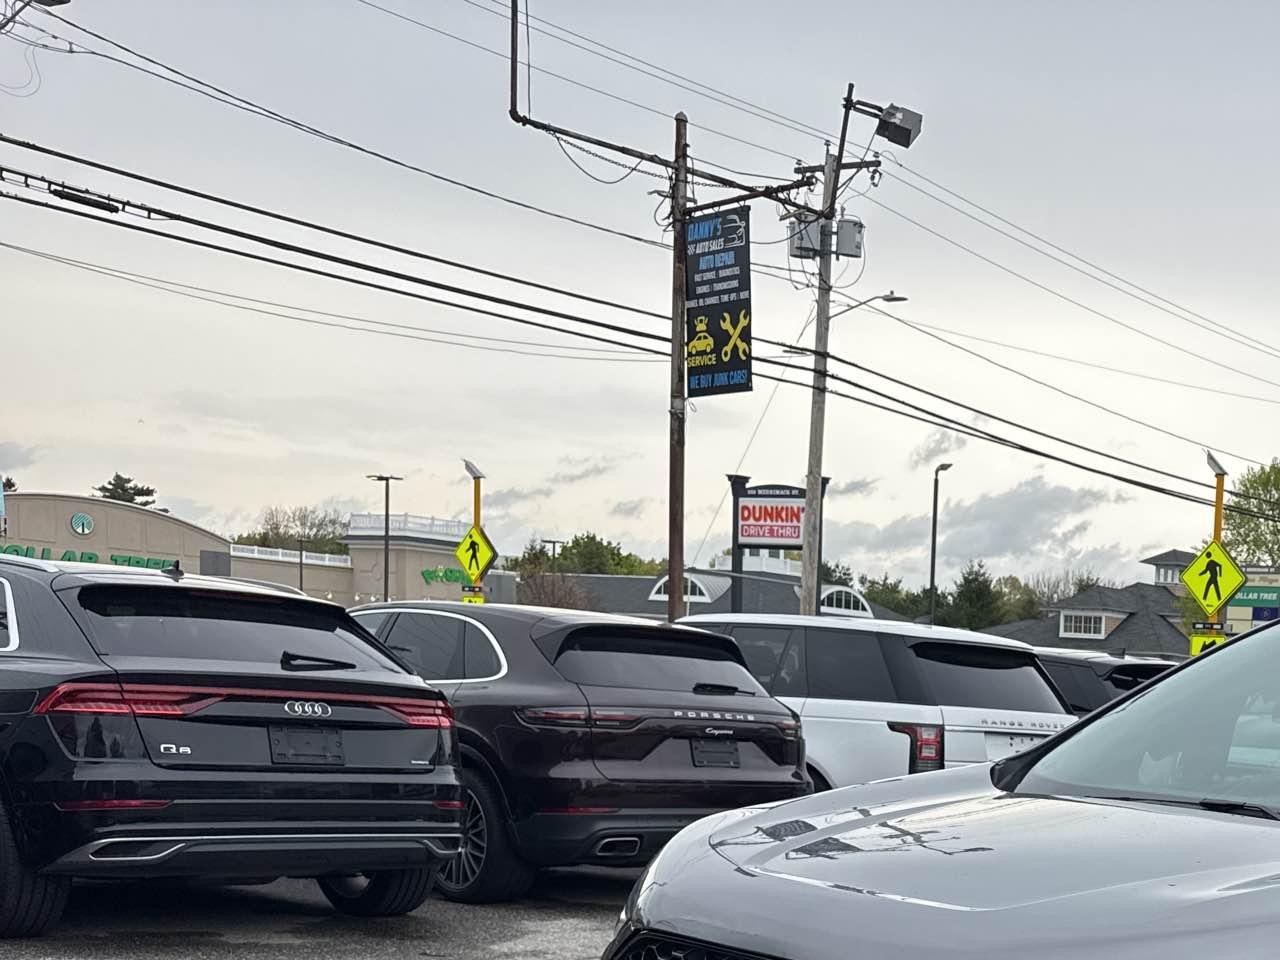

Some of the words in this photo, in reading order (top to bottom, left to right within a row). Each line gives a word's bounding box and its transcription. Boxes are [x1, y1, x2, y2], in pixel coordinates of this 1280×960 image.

[709, 238, 724, 251] SALES
[687, 353, 717, 367] SERVICE
[741, 505, 805, 523] DUNKIN'
[743, 526, 770, 537] DRIVE
[773, 527, 799, 538] THRU
[1259, 592, 1278, 601] TREE
[674, 711, 755, 721] PORSCHE
